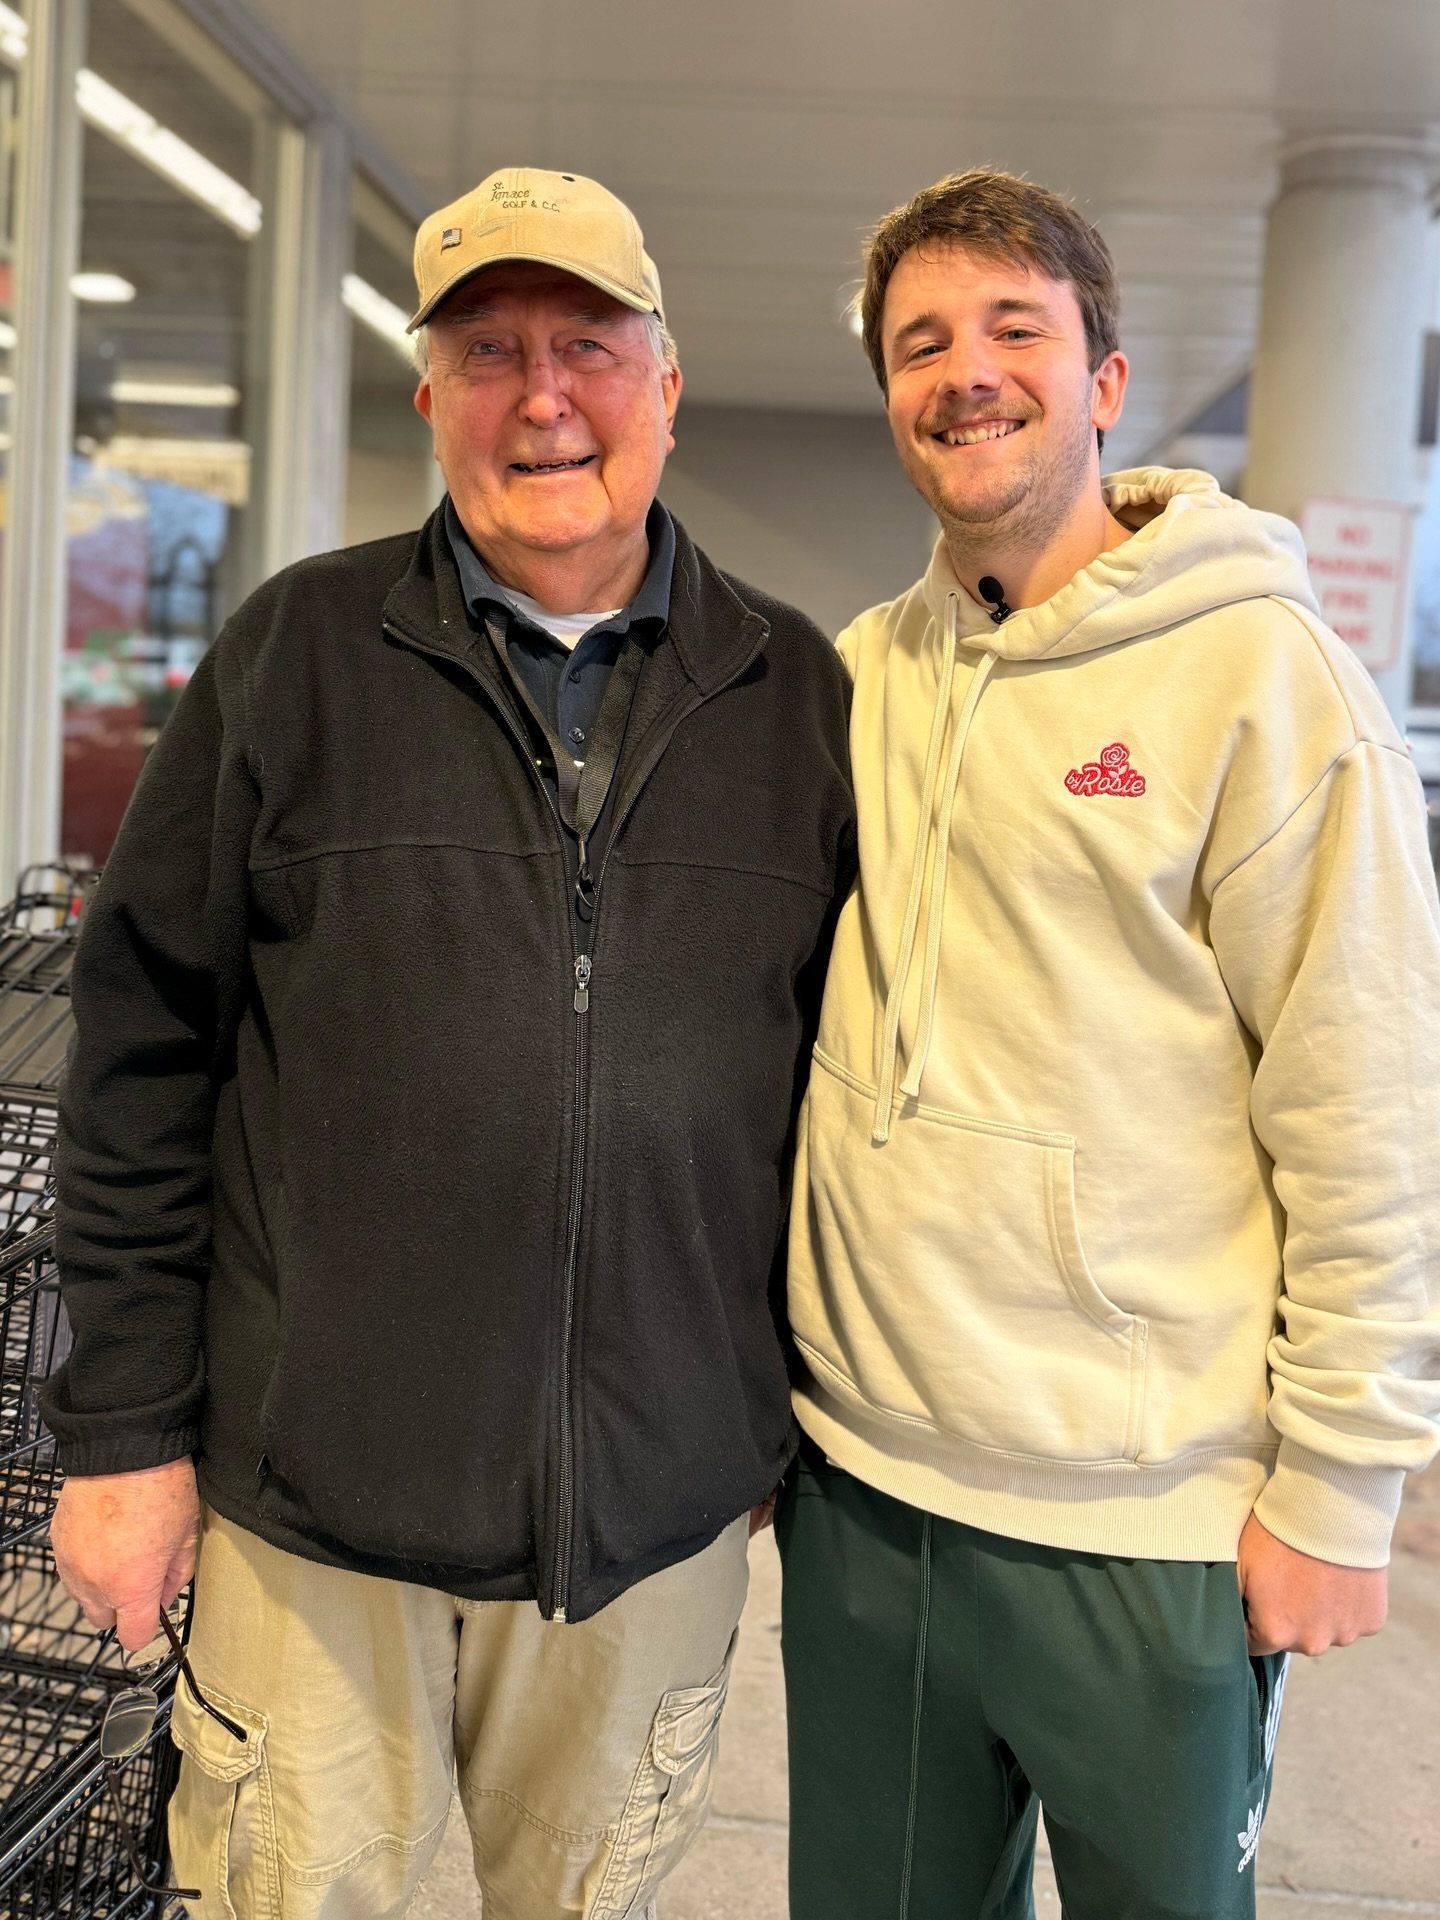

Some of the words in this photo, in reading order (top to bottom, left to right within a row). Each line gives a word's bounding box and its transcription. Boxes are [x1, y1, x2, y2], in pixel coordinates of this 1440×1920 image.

[492, 182, 504, 191] St.
[491, 190, 530, 201] Ignace
[502, 200, 527, 208] GOLF
[531, 200, 537, 208] &
[542, 201, 561, 212] C.C.
[1331, 624, 1371, 644] ANE
[1065, 771, 1083, 790] by
[1077, 765, 1145, 795] Rosie
